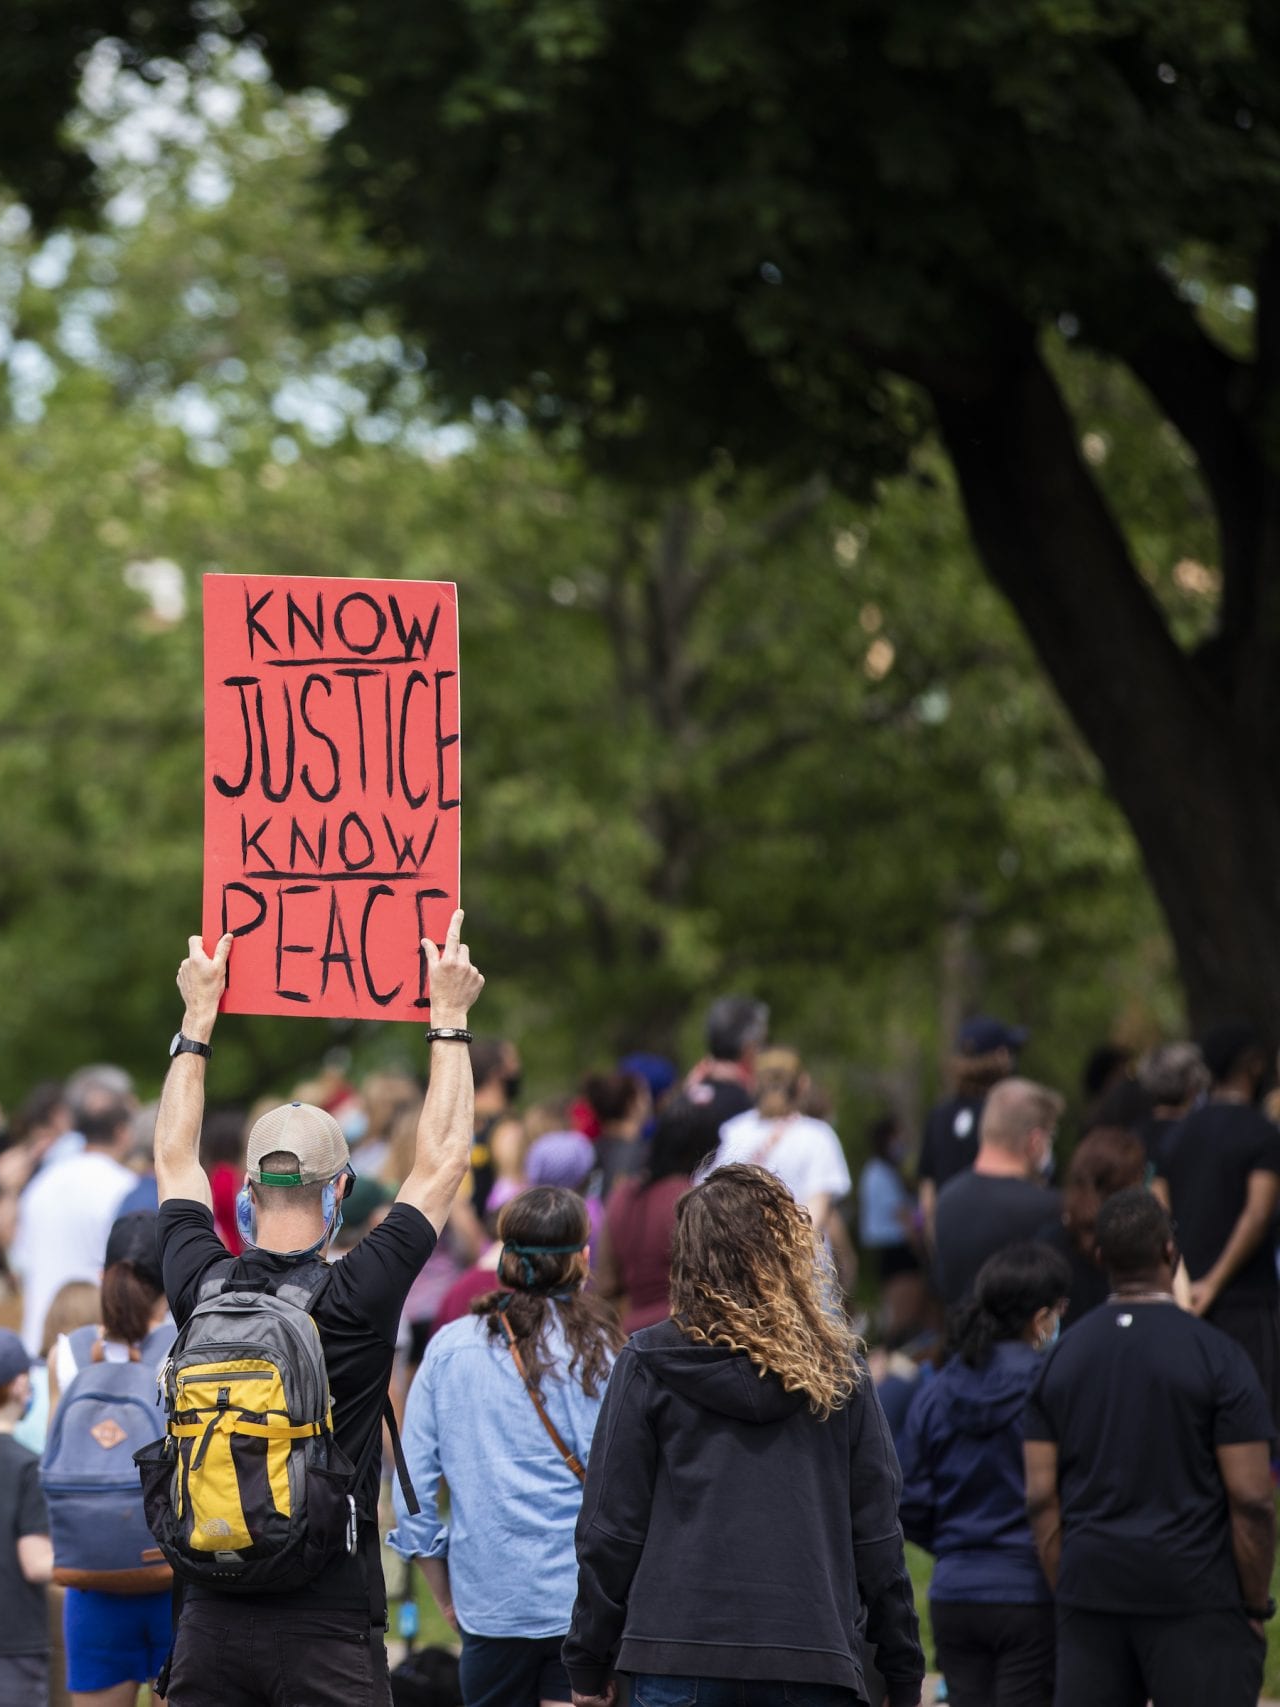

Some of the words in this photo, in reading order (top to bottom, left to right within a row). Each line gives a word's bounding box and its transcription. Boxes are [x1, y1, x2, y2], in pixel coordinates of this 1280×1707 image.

[243, 582, 440, 661] KNOW
[213, 667, 461, 810] JUSTICE
[241, 811, 439, 871] KNOW
[222, 882, 450, 1008] PEACE
